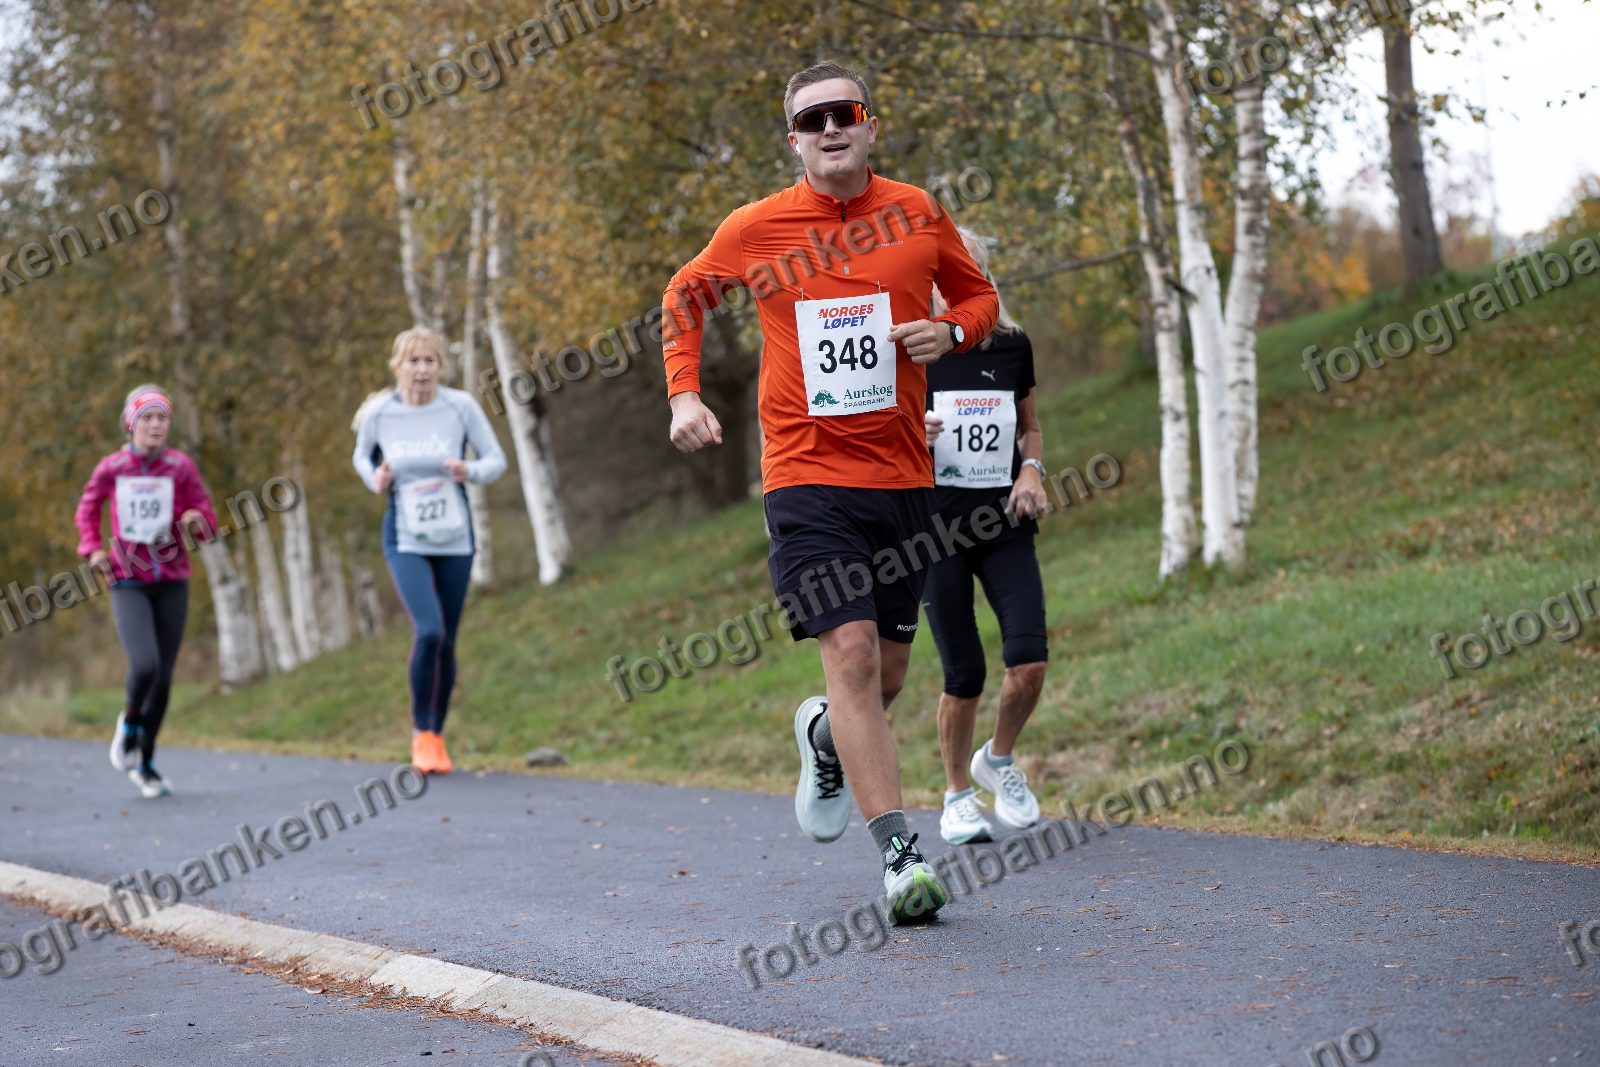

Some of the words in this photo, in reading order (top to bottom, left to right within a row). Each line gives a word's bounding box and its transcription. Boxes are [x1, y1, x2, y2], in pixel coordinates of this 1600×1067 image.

[817, 303, 874, 319] NORGES
[823, 315, 868, 330] LØPET
[818, 335, 878, 374] 348
[843, 384, 893, 400] Aurskog
[844, 397, 886, 409] SPAREBANK
[954, 398, 1002, 407] NORGES
[957, 406, 994, 416] LØPET
[952, 423, 1000, 453] 182
[968, 465, 1008, 477] Aurskog
[130, 499, 161, 519] 159
[416, 499, 447, 522] 227
